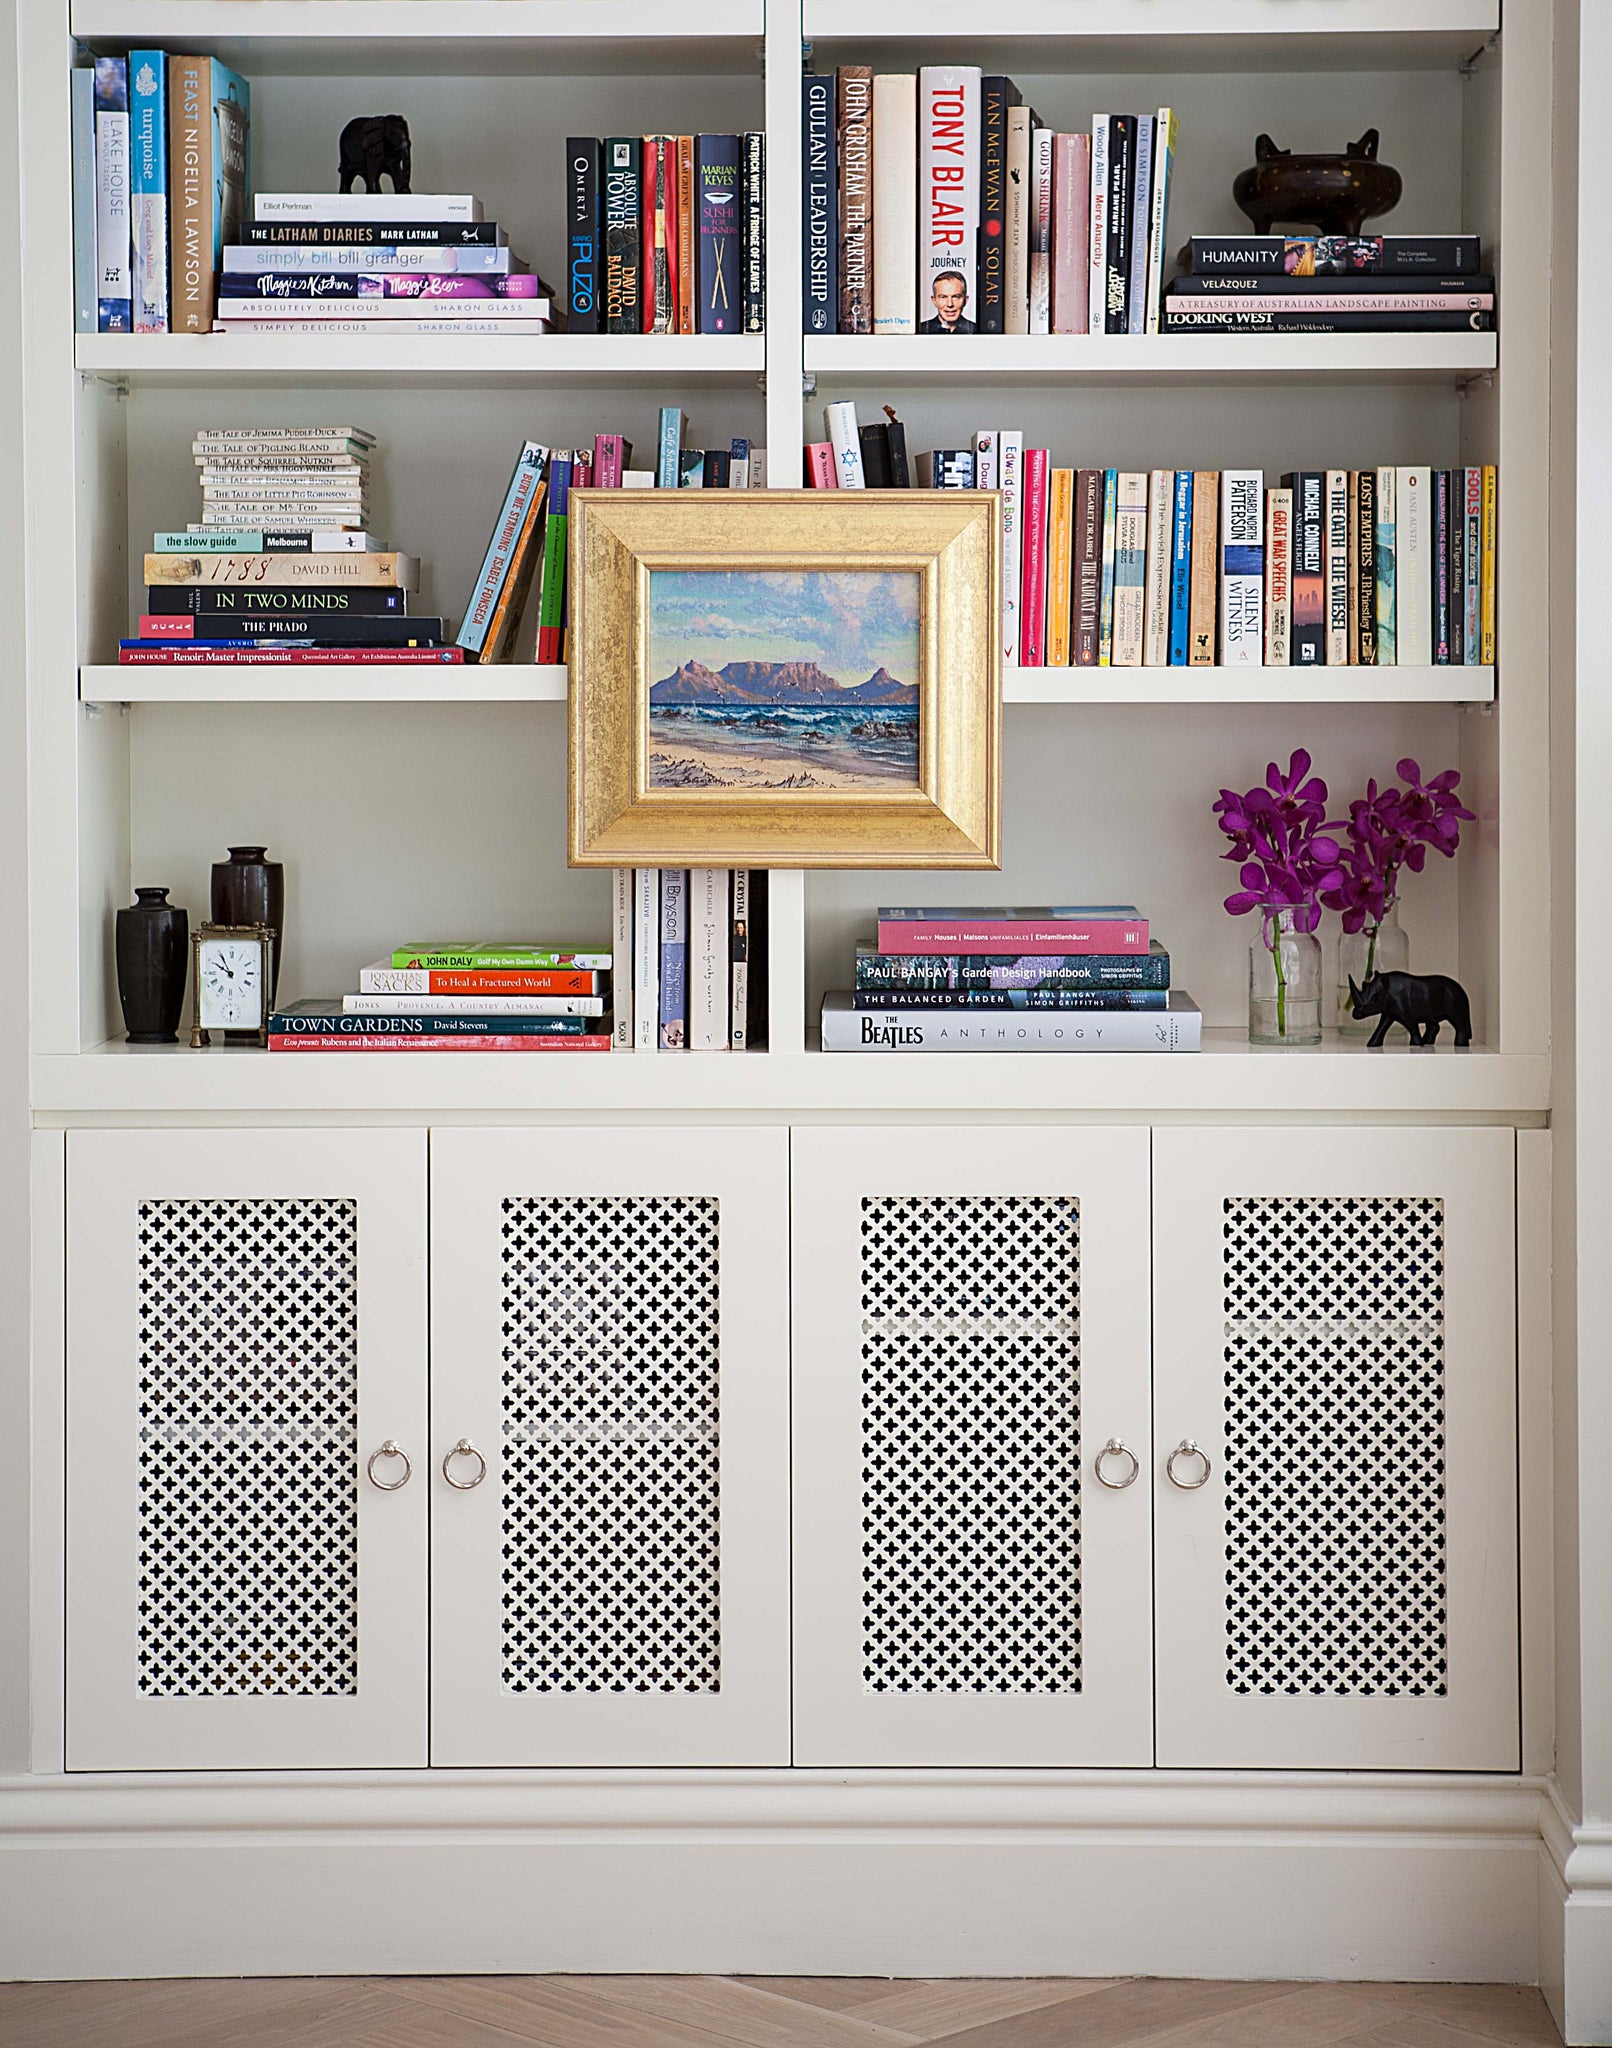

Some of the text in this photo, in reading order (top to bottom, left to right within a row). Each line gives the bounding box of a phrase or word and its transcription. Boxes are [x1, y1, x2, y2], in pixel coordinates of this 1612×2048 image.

[139, 108, 157, 179] turquoise
[749, 136, 759, 173] PATRICK
[111, 120, 123, 216] LAKE HOUSE
[702, 165, 736, 174] MARIAN
[705, 175, 733, 185] KEYES
[932, 85, 964, 246] TONY BLAIR
[185, 70, 199, 301] FEAST NIGELLA LAWSON
[751, 174, 759, 202] WHITE
[810, 86, 828, 301] GIULIANI LEADERSHIP
[845, 77, 870, 290] JOHN GRISHAM THE PARTNER
[1039, 141, 1050, 223] GOD'S SHRINK
[1093, 126, 1105, 267] Woody Allen Mere Anarchy
[608, 173, 624, 231] POWER
[625, 172, 636, 229] ABSOLUTE
[987, 93, 999, 305] IAN McEWAN SOLAR
[251, 228, 438, 241] THE LATHAM DIARIES MARK LATHAM
[751, 214, 759, 247] FRINGE
[257, 252, 424, 267] simply bill bill granger
[751, 249, 759, 259] OF
[931, 257, 967, 268] JOURNEY
[1203, 251, 1278, 262] HUMANITY
[573, 243, 593, 313] PUZO
[608, 255, 622, 318] BALDACCI
[623, 266, 636, 305] DAVID
[750, 261, 759, 293] LEAVES
[1203, 278, 1257, 290] VELÁZQUEZ
[1167, 313, 1274, 324] LOOKING WEST
[1186, 300, 1240, 308] TREASURY
[1004, 446, 1017, 533] Edward de Bono
[1086, 476, 1096, 559] MARGARET DRABBLE
[1231, 480, 1246, 540] PATTERSON
[1246, 480, 1258, 540] RICHARD NORTH
[1305, 479, 1319, 572] MICHAEL CONNELLY
[1361, 476, 1371, 566] LOST EMPIRES
[167, 536, 308, 548] the slow guide Melbourne
[472, 473, 534, 625] BURY ME STANDING ISABEL FONSECA
[1272, 510, 1287, 602] GREAT WAR SPEECHES
[1453, 547, 1461, 567] Tiger
[211, 557, 360, 580] 1788 DAVID HILL
[1332, 489, 1345, 632] THE OATH ELIE WIESEL
[1454, 569, 1462, 593] Rising
[216, 594, 348, 608] IN TWO MINDS
[1228, 581, 1243, 642] WITNESS
[1245, 588, 1259, 635] SILENT
[243, 622, 307, 632] THE PRADO
[174, 652, 291, 663] Renoir: Master Impressionist
[664, 886, 681, 940] Bryson
[427, 957, 472, 966] JOHN DALY
[867, 967, 1091, 980] PAUL BANGAY's Garden Design Handbook
[374, 981, 422, 991] SACKS
[436, 978, 447, 987] To
[450, 978, 470, 987] Heal
[480, 978, 521, 988] Fractured
[524, 978, 551, 987] World
[958, 995, 1004, 1003] GARDEN
[282, 1018, 488, 1031] TOWN GARDENS David Stevens
[861, 1017, 923, 1049] BEATLES
[885, 1016, 898, 1024] THE
[940, 1029, 1104, 1038] ANTHOLOGY
